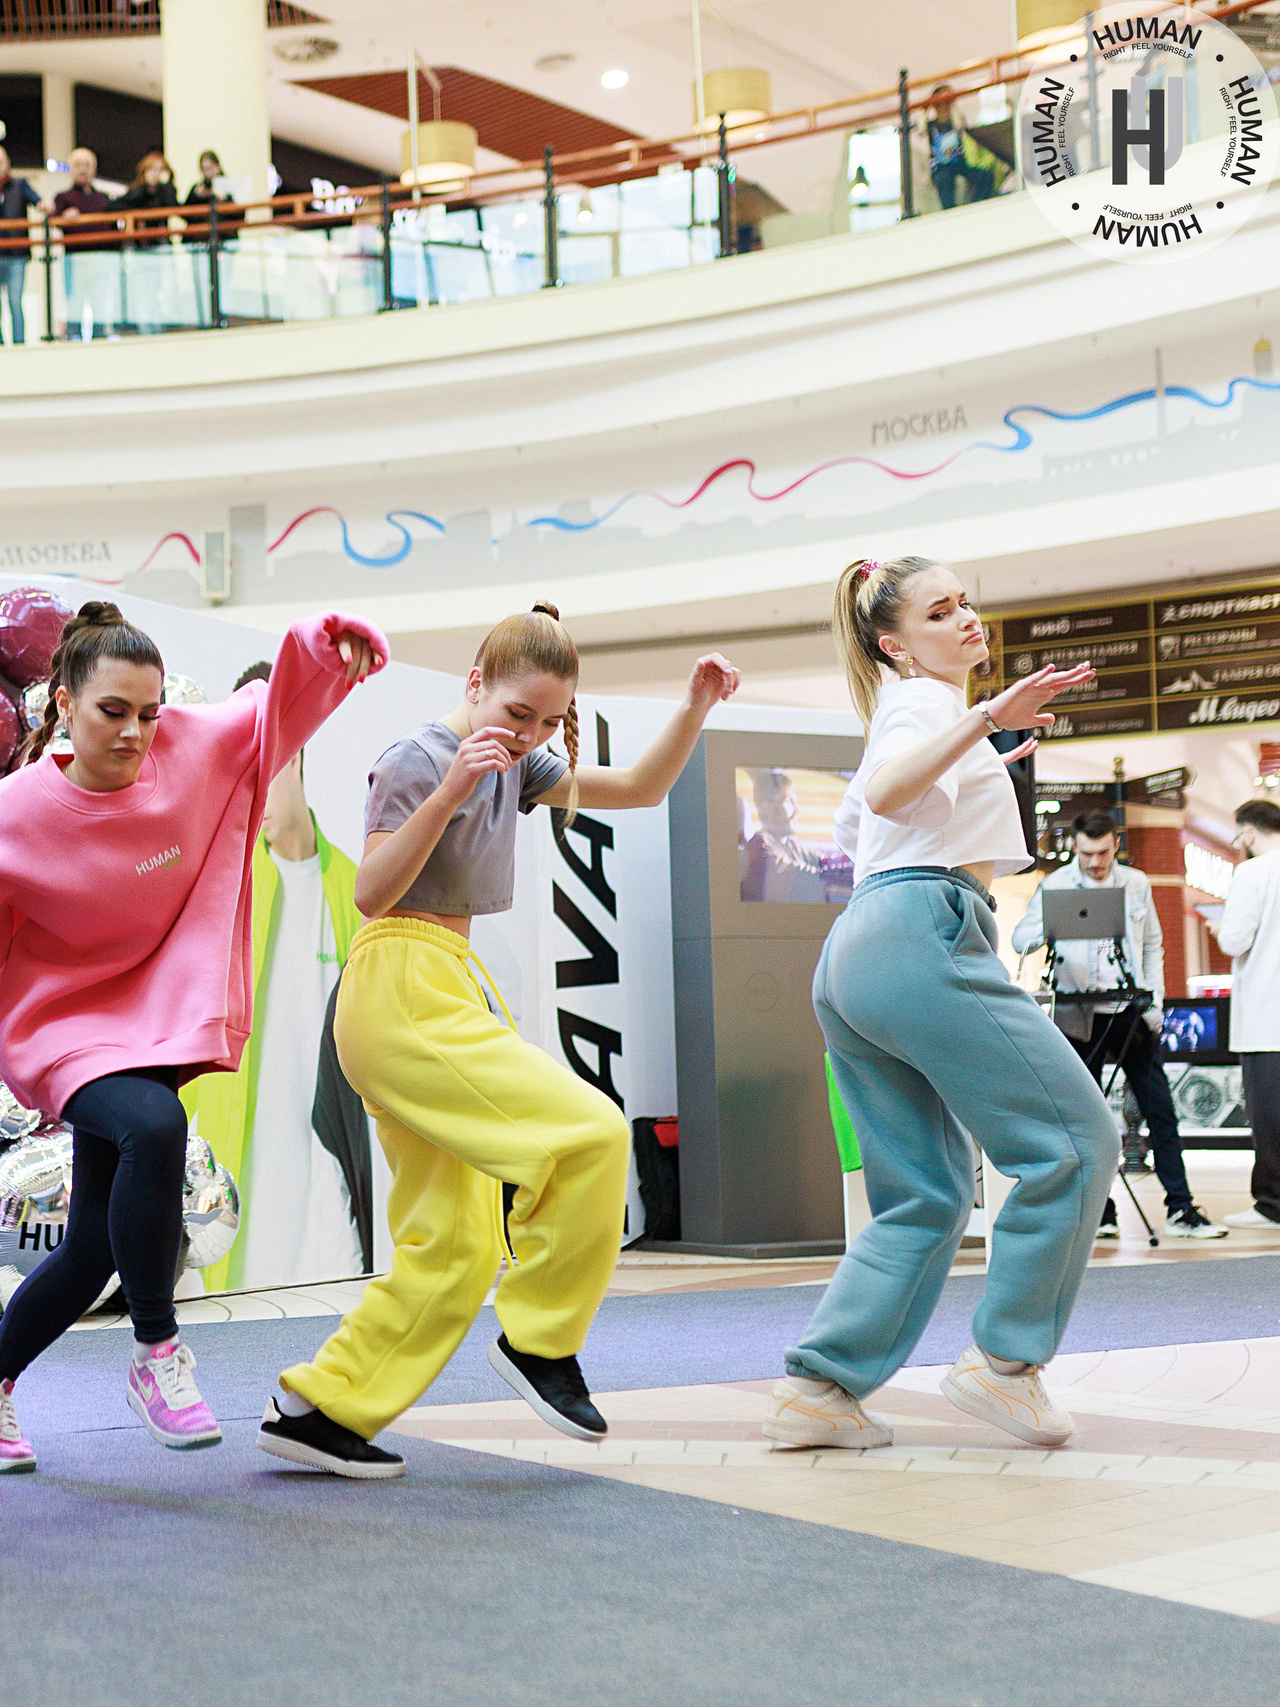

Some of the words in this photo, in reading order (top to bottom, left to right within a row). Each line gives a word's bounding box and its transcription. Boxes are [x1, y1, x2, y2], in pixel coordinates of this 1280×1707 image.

[871, 404, 969, 447] МОСКВА
[0, 541, 111, 567] МОСКВА
[135, 844, 181, 877] HUMAN
[19, 1221, 64, 1252] HU
